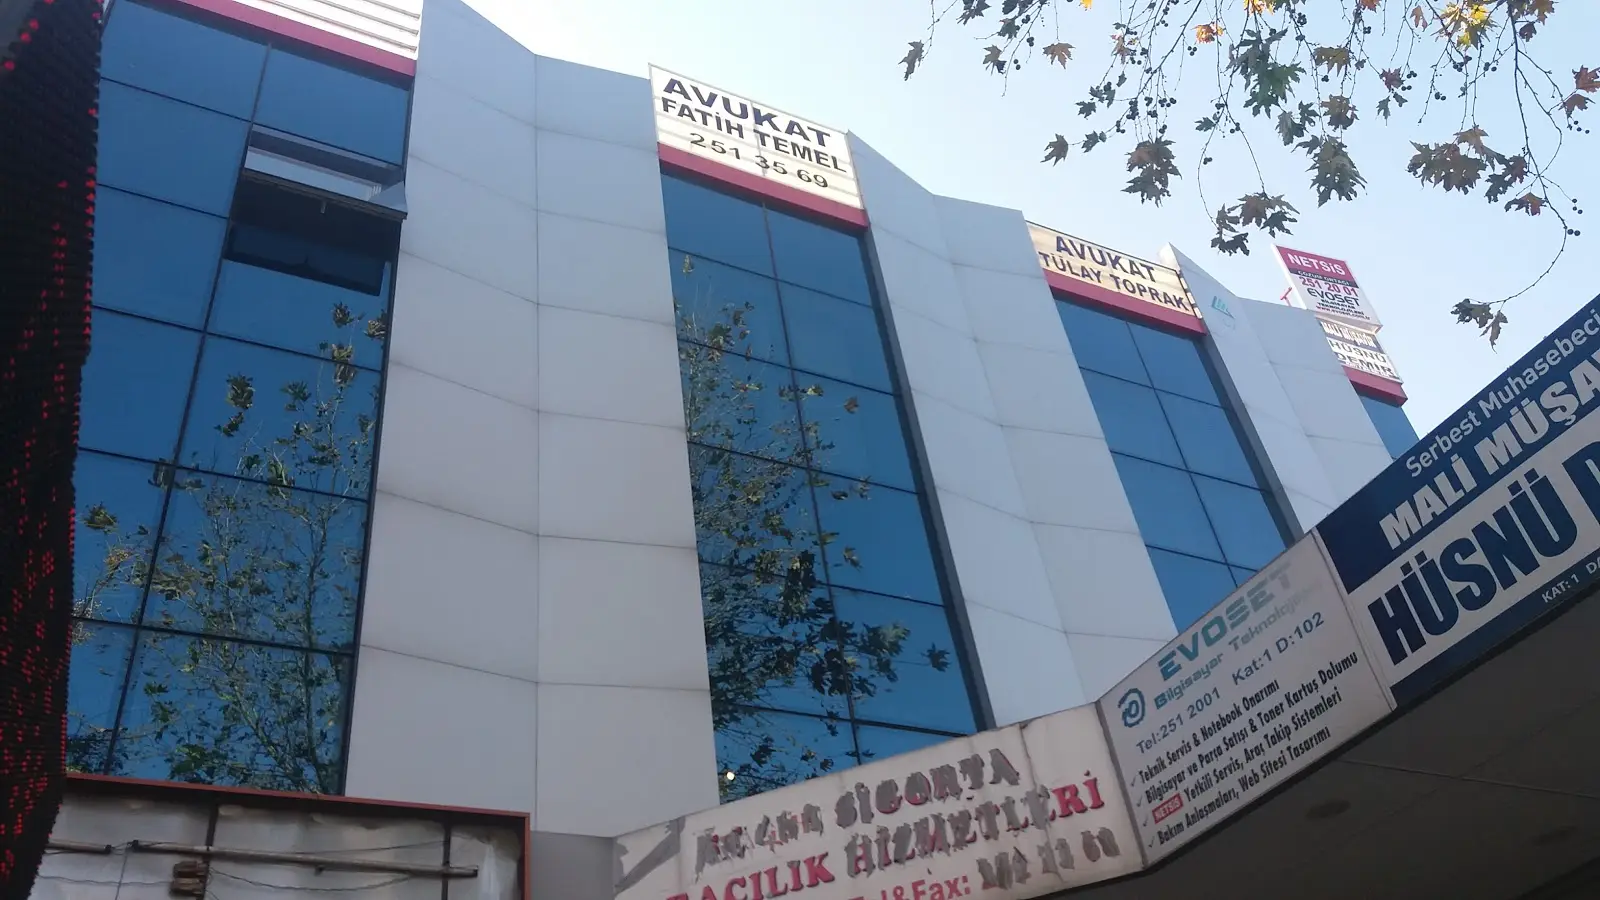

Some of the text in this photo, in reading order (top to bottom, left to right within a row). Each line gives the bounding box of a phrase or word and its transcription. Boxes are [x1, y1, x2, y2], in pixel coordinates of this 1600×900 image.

[663, 78, 830, 147] AVUKAT
[690, 132, 828, 188] 251 35 69
[753, 129, 847, 172] TEMEL
[1038, 251, 1189, 311] TÜLAY TOPRAK
[1056, 236, 1155, 282] AVUKAT
[1299, 277, 1322, 289] 251
[1324, 281, 1340, 293] 20
[1344, 286, 1359, 297] 01
[1307, 288, 1360, 306] EVOSET
[1378, 348, 1600, 550] MALİ MÜŞA
[1406, 410, 1481, 477] Serbest
[1367, 467, 1578, 666] HÜSNÜ
[1158, 561, 1291, 681] EVOSET
[1136, 713, 1184, 754] Tel:251
[1187, 687, 1221, 719] 2001
[1276, 611, 1324, 653] D:102
[1153, 652, 1224, 709] Bilgisayar
[1138, 756, 1167, 784] Teknik
[1166, 740, 1192, 765] Servis
[1192, 733, 1201, 747] &
[1200, 703, 1242, 742] Notebook
[1145, 770, 1185, 804] Bilgisayar
[1188, 762, 1198, 776] ve
[1198, 746, 1223, 768] Parça
[1249, 719, 1258, 733] &
[1257, 701, 1285, 727] Toner
[1285, 680, 1319, 709] Kartuş
[1318, 652, 1358, 685] Dolumu
[1184, 772, 1213, 802] Yetkili
[1212, 756, 1244, 783] Servis,
[1243, 742, 1266, 764] Araç
[1264, 723, 1292, 750] Takip
[1291, 686, 1342, 731] Sistemleri
[1157, 821, 1184, 844] Bakım
[1237, 769, 1260, 792] Web
[1260, 752, 1288, 779] Sitesi
[1287, 726, 1331, 760] Tasarımı
